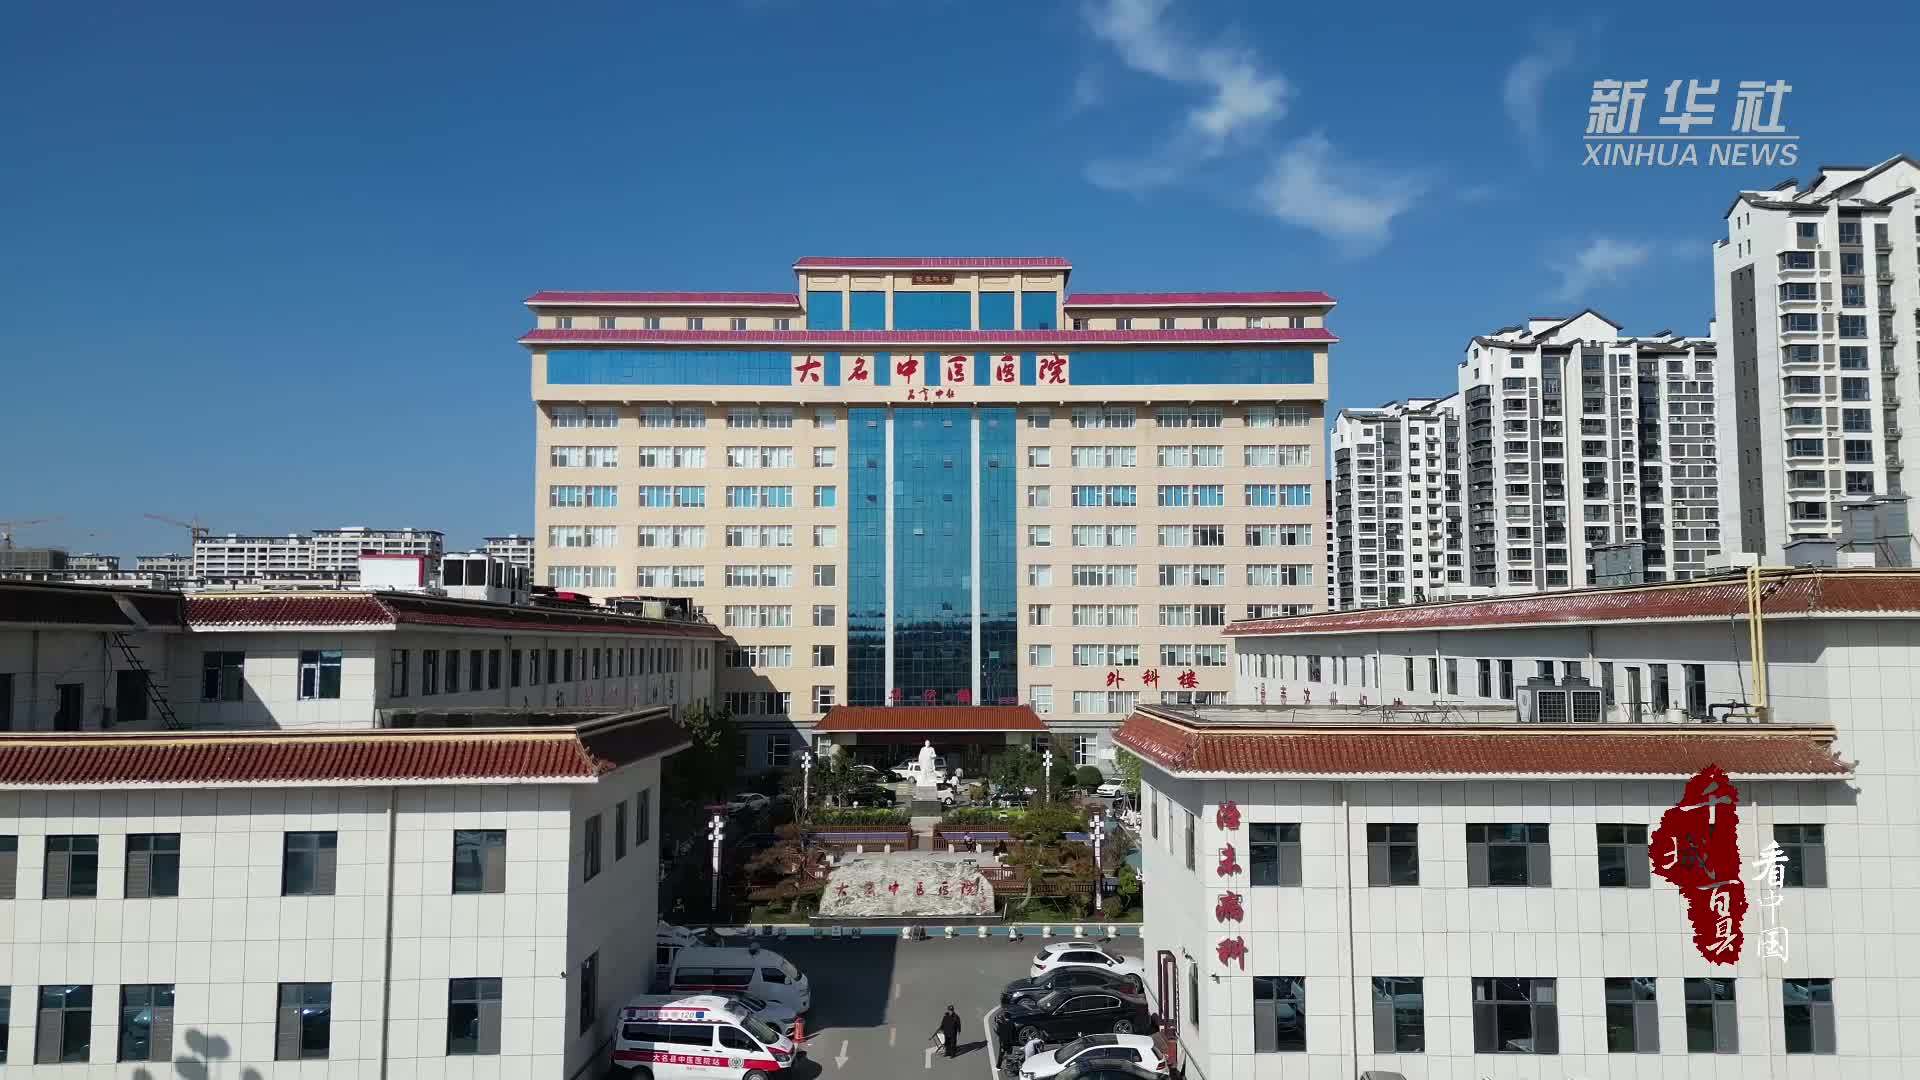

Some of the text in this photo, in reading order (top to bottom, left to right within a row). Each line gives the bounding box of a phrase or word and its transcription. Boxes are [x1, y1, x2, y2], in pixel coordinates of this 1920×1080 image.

[794, 354, 1067, 385] 大名中医医院
[1106, 668, 1200, 691] 外科楼
